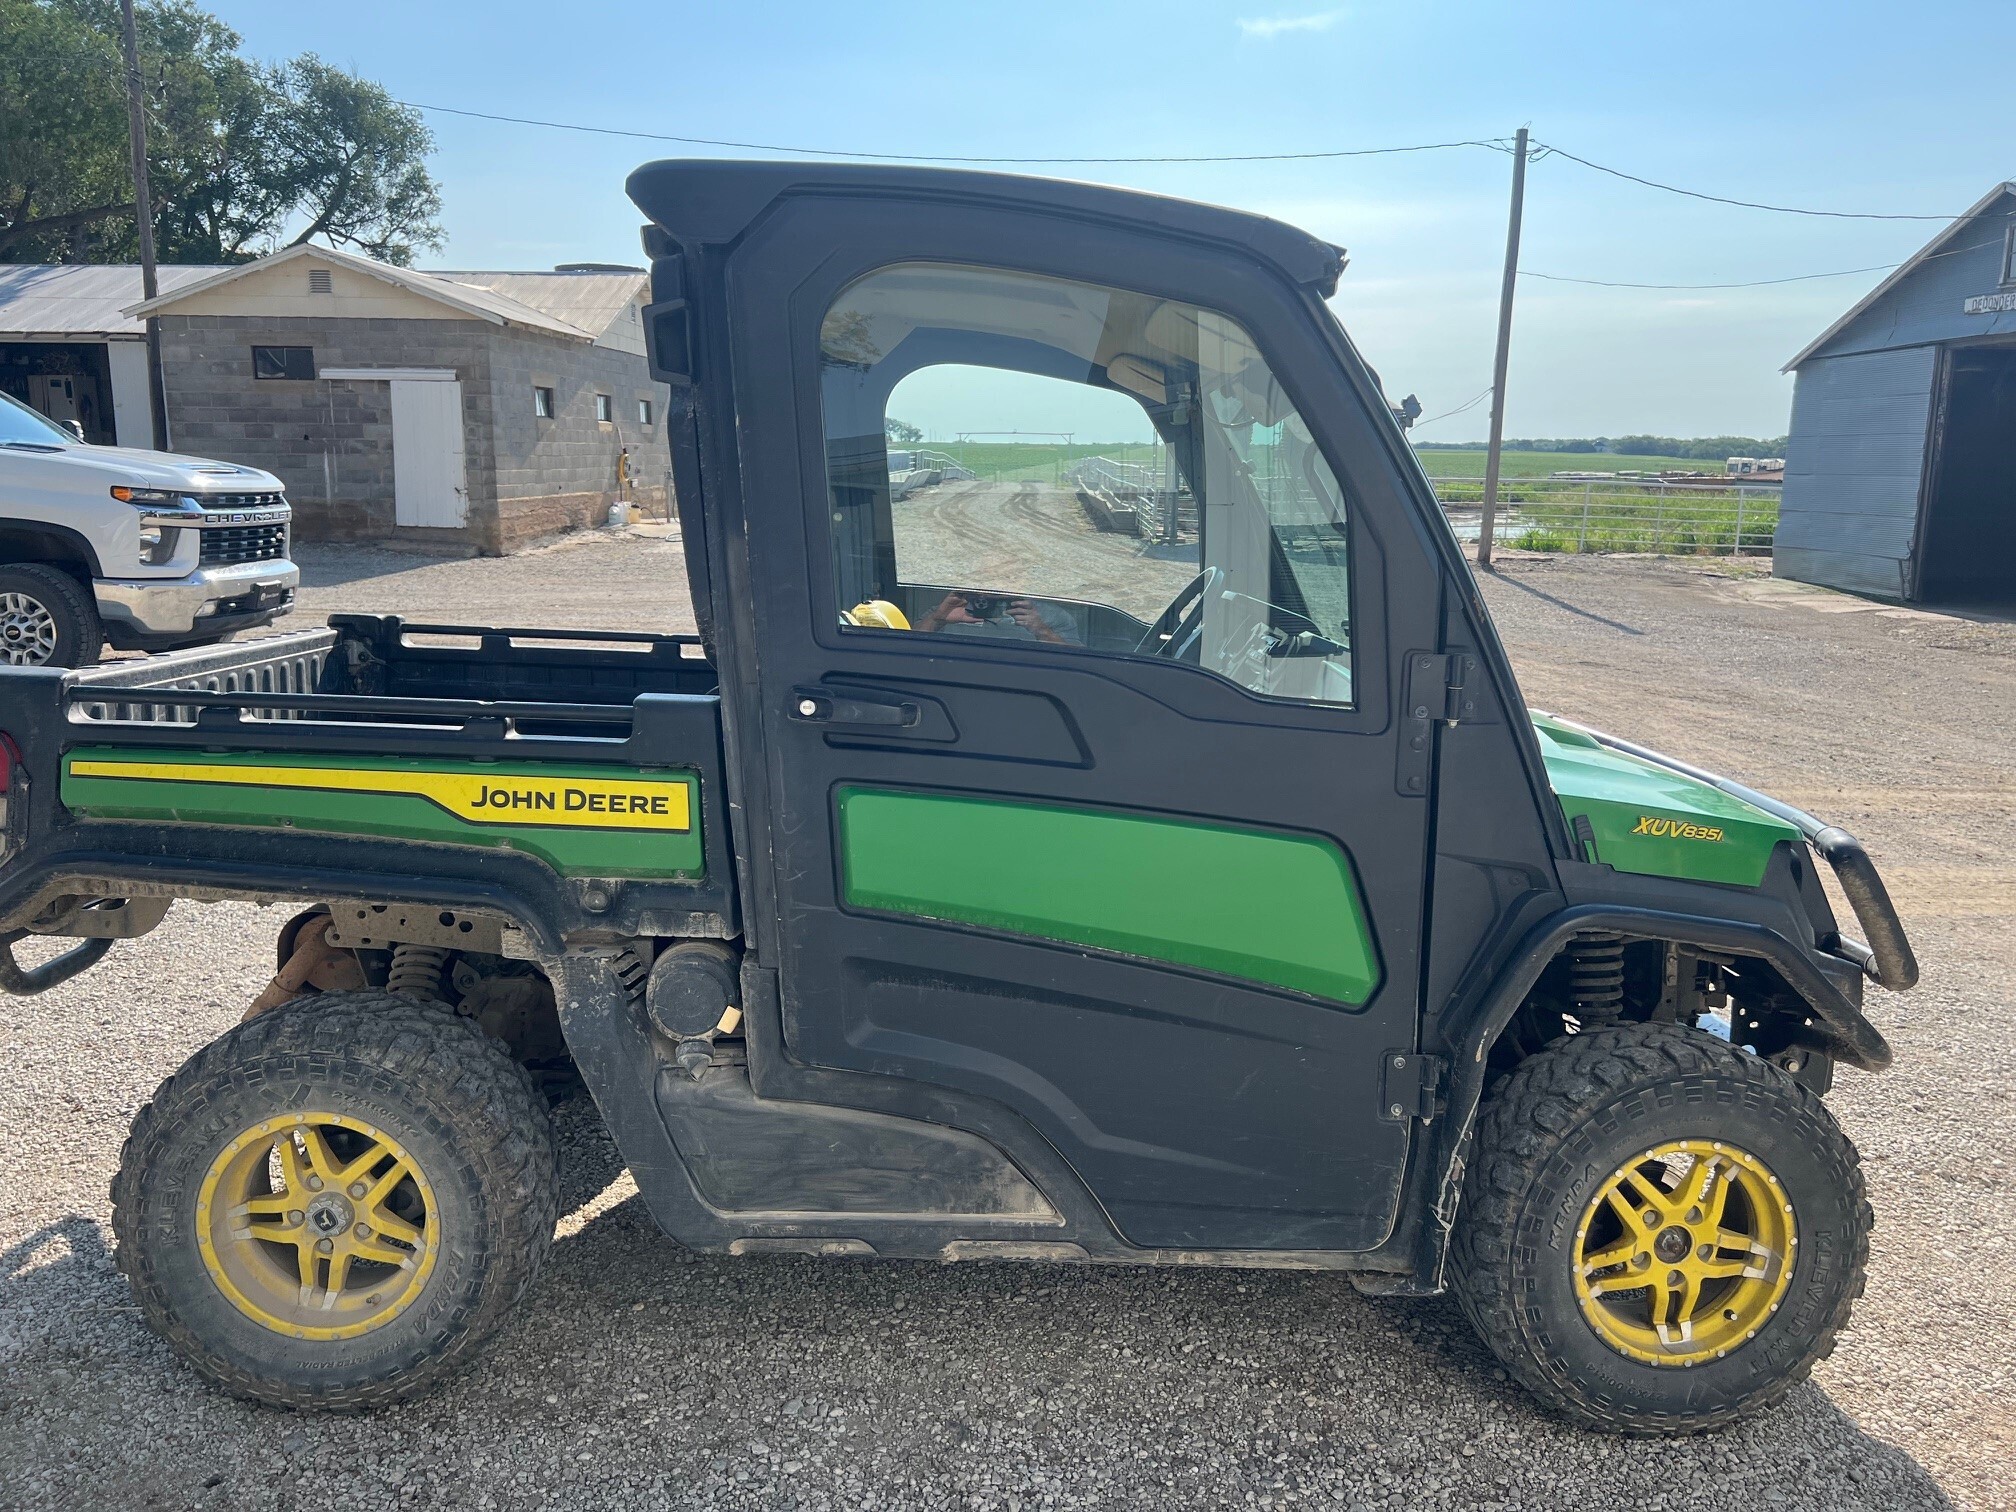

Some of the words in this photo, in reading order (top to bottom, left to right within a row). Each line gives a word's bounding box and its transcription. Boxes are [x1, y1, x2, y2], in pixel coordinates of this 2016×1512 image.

[205, 511, 290, 524] CHEVROLET
[471, 785, 555, 809] JOHN
[564, 789, 669, 815] DEERE
[159, 1138, 203, 1246] KLEVER
[1548, 1162, 1599, 1250] KENDA
[412, 1250, 464, 1335] KENDA
[1785, 1229, 1833, 1340] KLEVER
[294, 1361, 335, 1369] RADIAL
